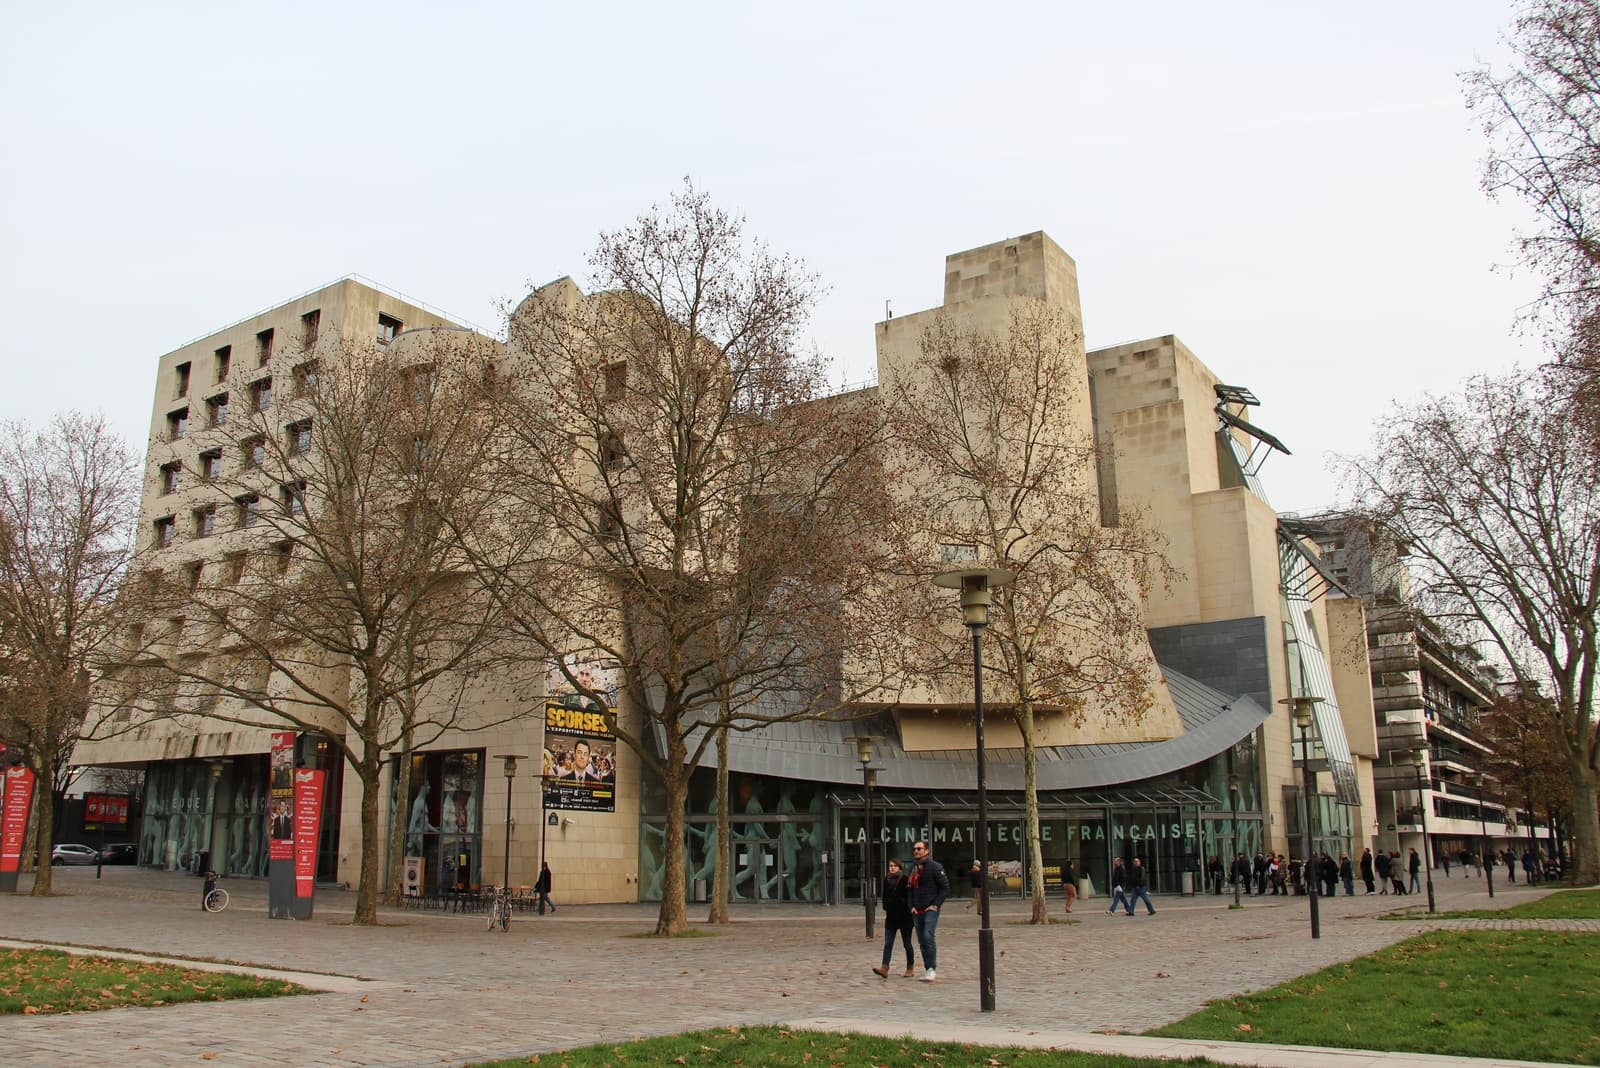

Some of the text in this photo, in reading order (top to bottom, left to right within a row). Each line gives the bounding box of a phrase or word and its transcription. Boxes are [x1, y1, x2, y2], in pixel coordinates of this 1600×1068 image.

[546, 707, 609, 733] SCORSES
[844, 823, 1196, 845] LA CINÉMATÈQE FRANÇAISE
